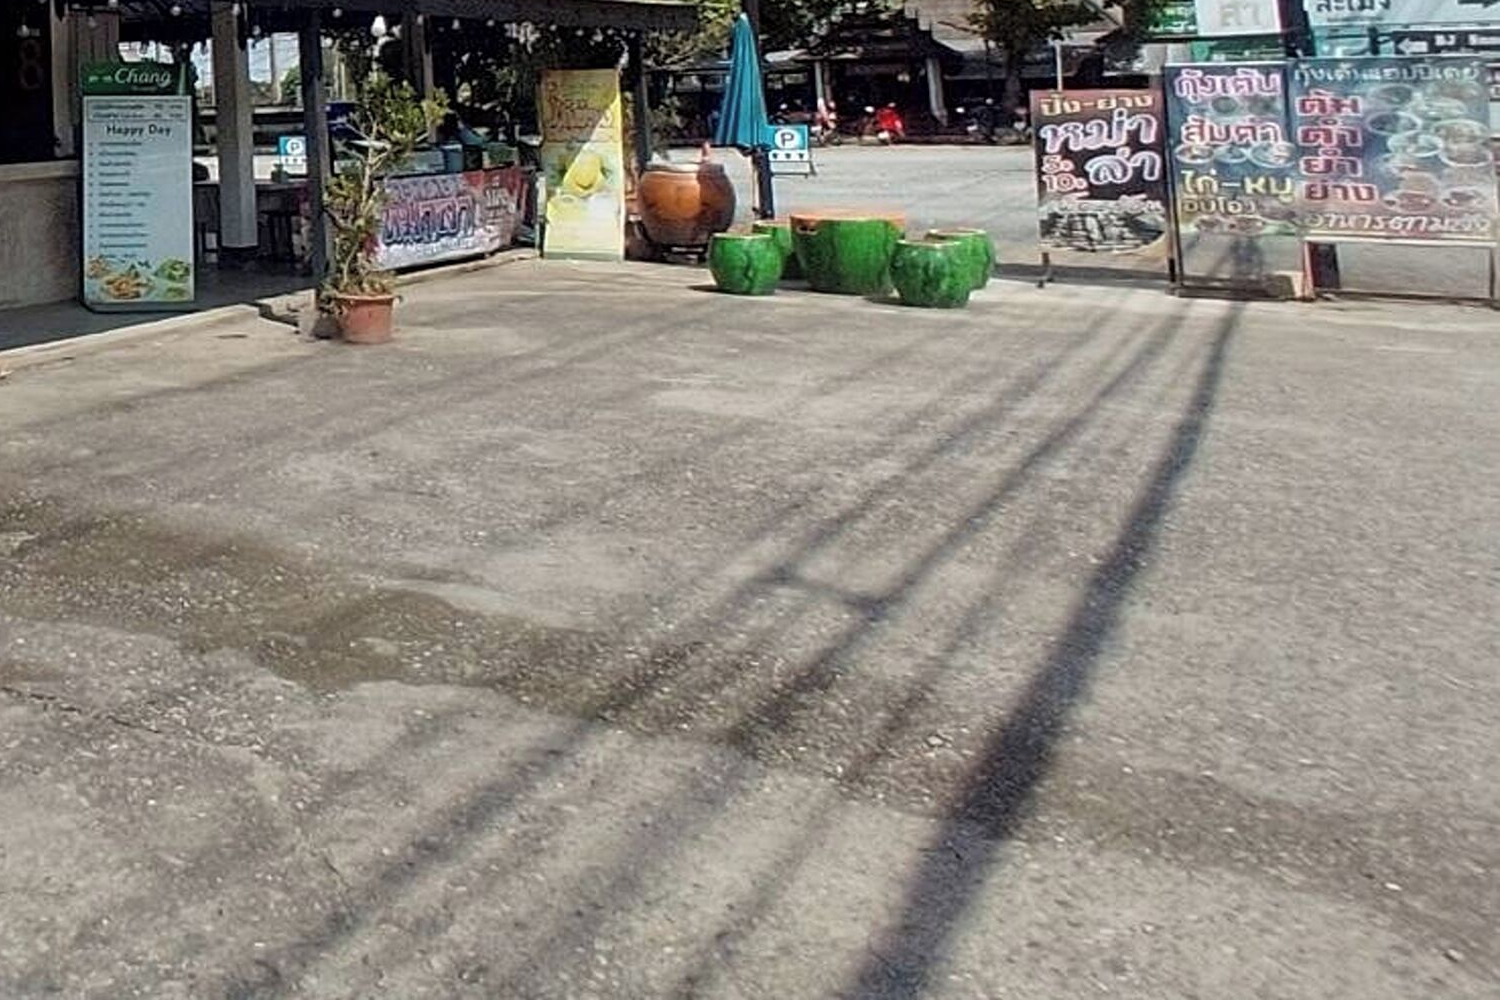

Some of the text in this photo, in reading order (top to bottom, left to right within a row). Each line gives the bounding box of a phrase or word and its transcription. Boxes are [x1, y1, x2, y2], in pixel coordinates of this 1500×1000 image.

[114, 67, 172, 89] Chang
[105, 124, 172, 137] Happy Day
[781, 132, 794, 147] P
